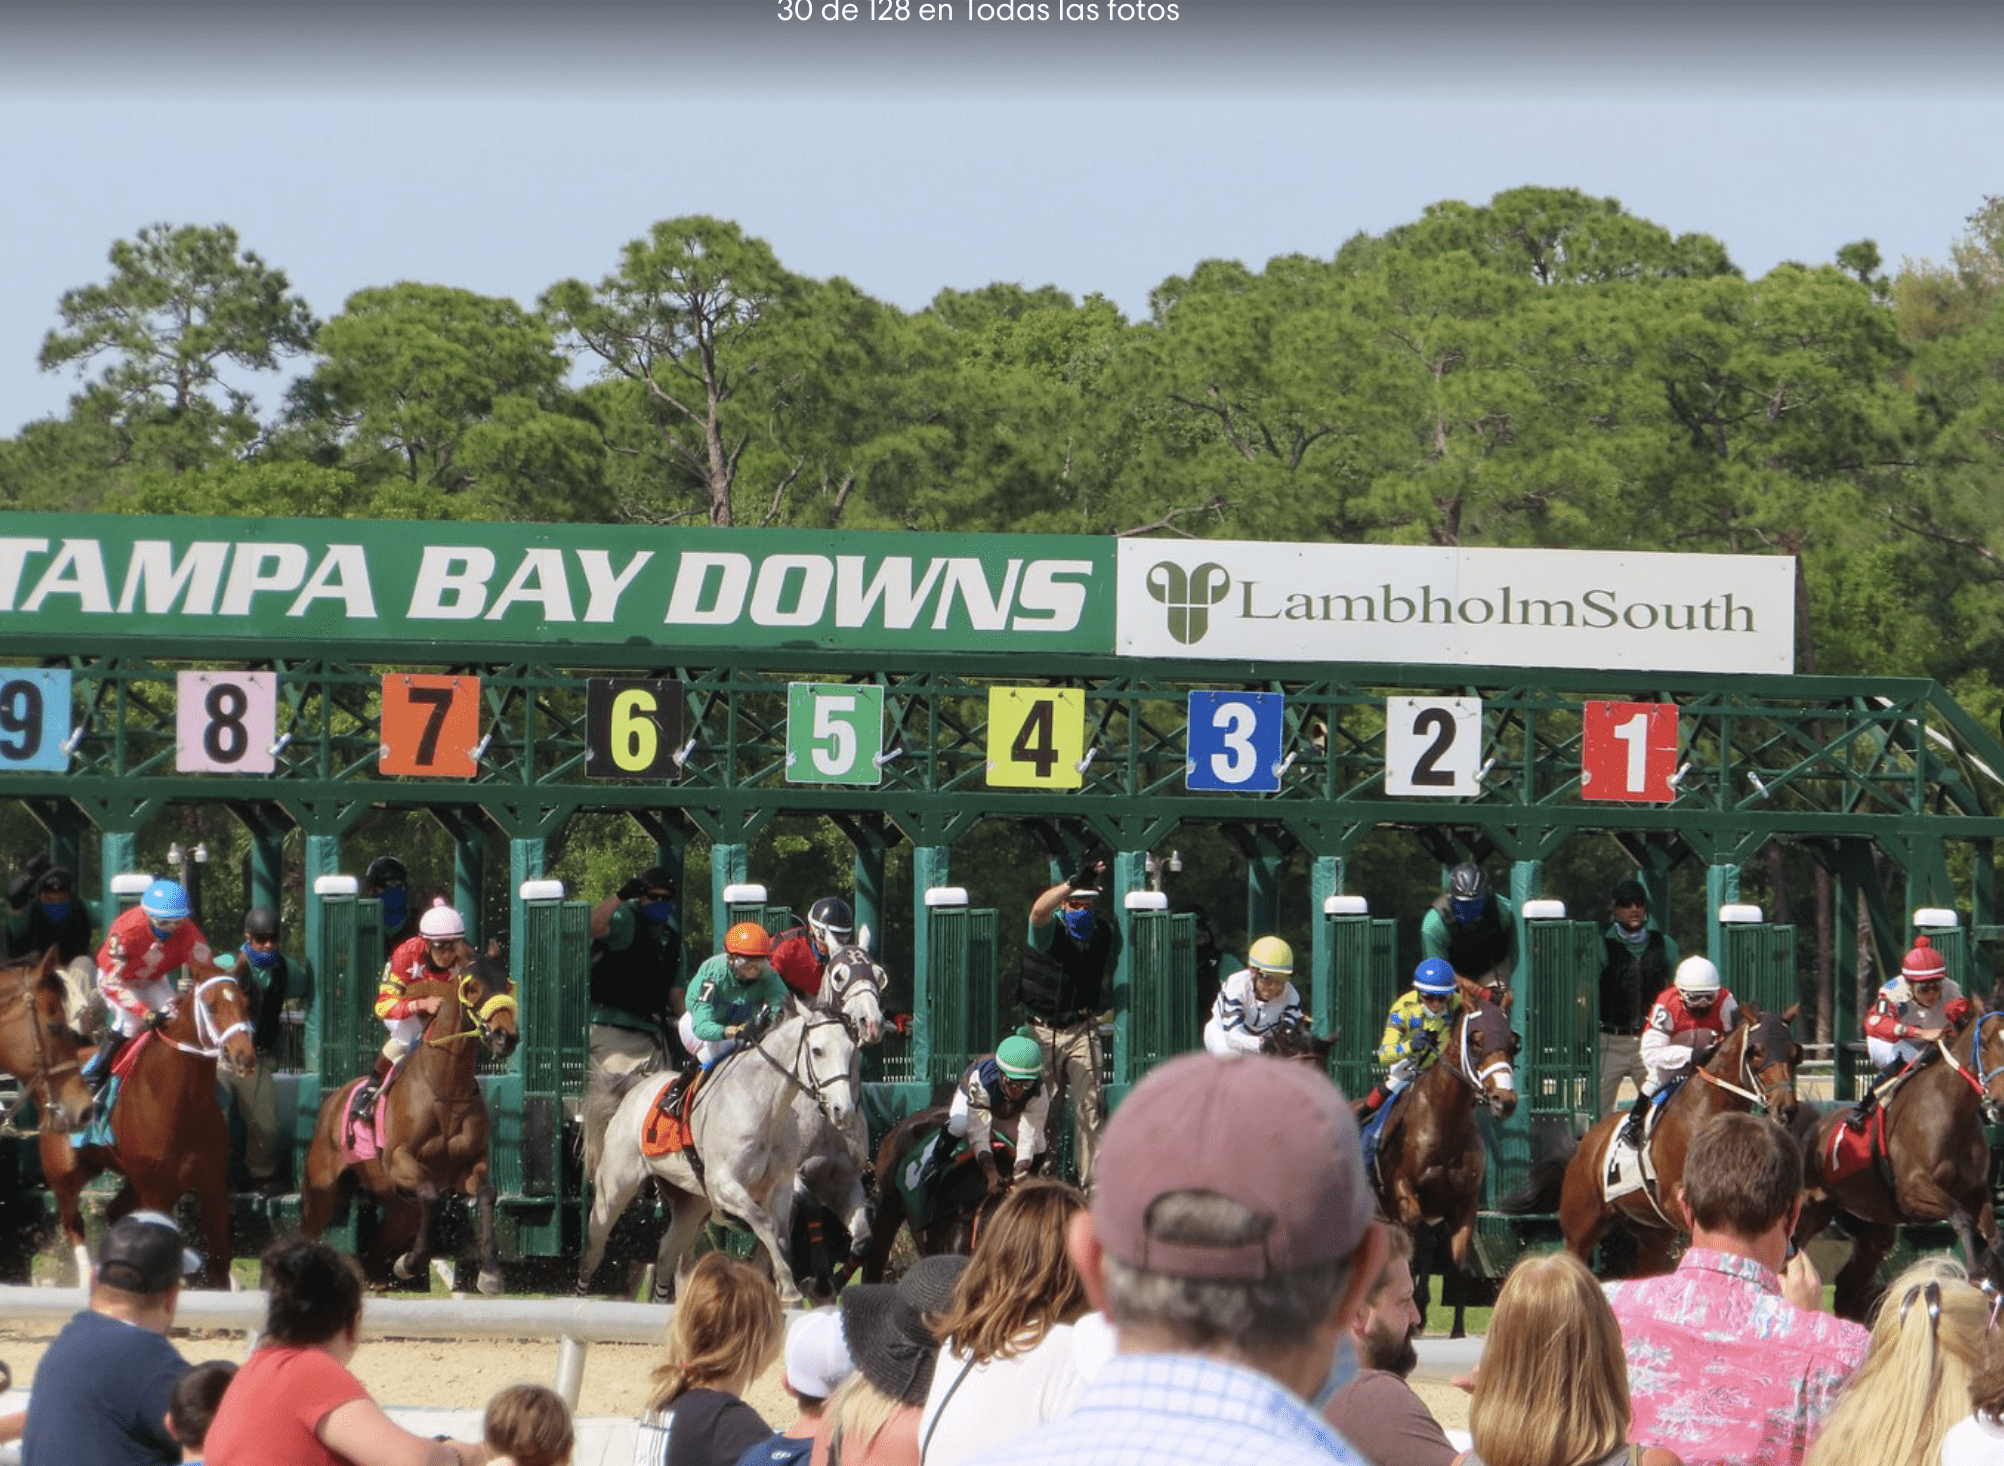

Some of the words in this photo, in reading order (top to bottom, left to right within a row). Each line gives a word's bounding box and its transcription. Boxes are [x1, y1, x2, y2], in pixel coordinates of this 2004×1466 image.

[0, 538, 378, 618] TAMPA
[405, 546, 655, 624] BAY
[664, 551, 1094, 632] DOWNS
[1236, 580, 1758, 633] LambholmSouth
[0, 680, 43, 761] 9
[204, 684, 248, 763] 8
[408, 687, 454, 766] 7
[610, 688, 659, 772] 6
[811, 695, 857, 776] 5
[1010, 700, 1059, 777] 4
[1211, 701, 1258, 783] 3
[1411, 707, 1456, 786] 2
[1614, 713, 1648, 792] 1
[702, 982, 714, 1001] 7
[1655, 1010, 1667, 1029] 2
